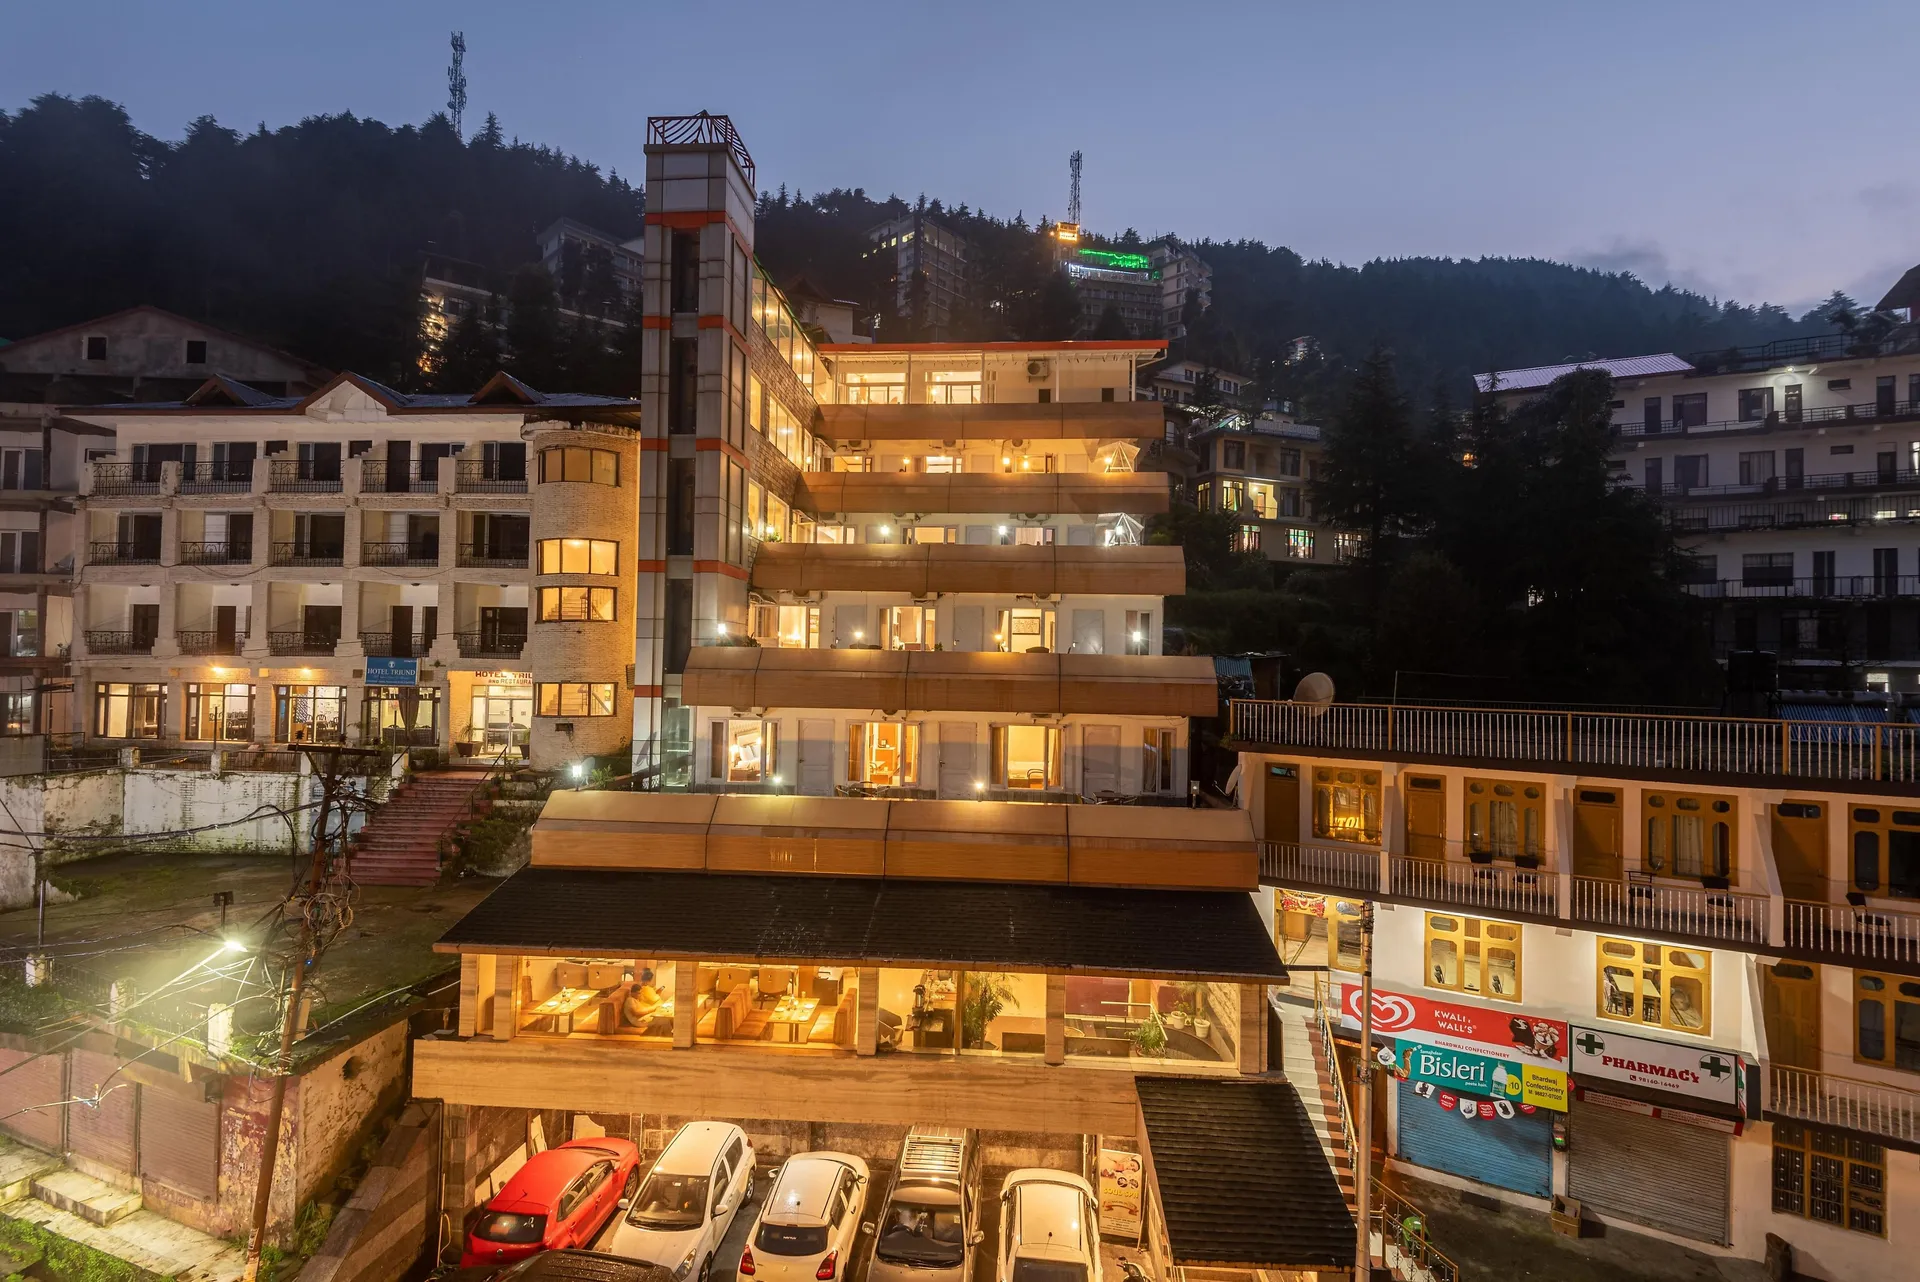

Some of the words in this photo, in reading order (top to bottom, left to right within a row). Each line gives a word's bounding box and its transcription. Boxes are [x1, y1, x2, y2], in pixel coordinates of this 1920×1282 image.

[1437, 1020, 1473, 1034] WALL'S
[1434, 1039, 1464, 1049] BHARDWAJ
[1464, 1045, 1510, 1058] CONFECTIONERY
[1419, 1054, 1485, 1082] Bisleri
[1602, 1055, 1700, 1083] PHARMACY
[1525, 1080, 1565, 1095] Confectionery
[1531, 1073, 1558, 1086] Bhardwaj
